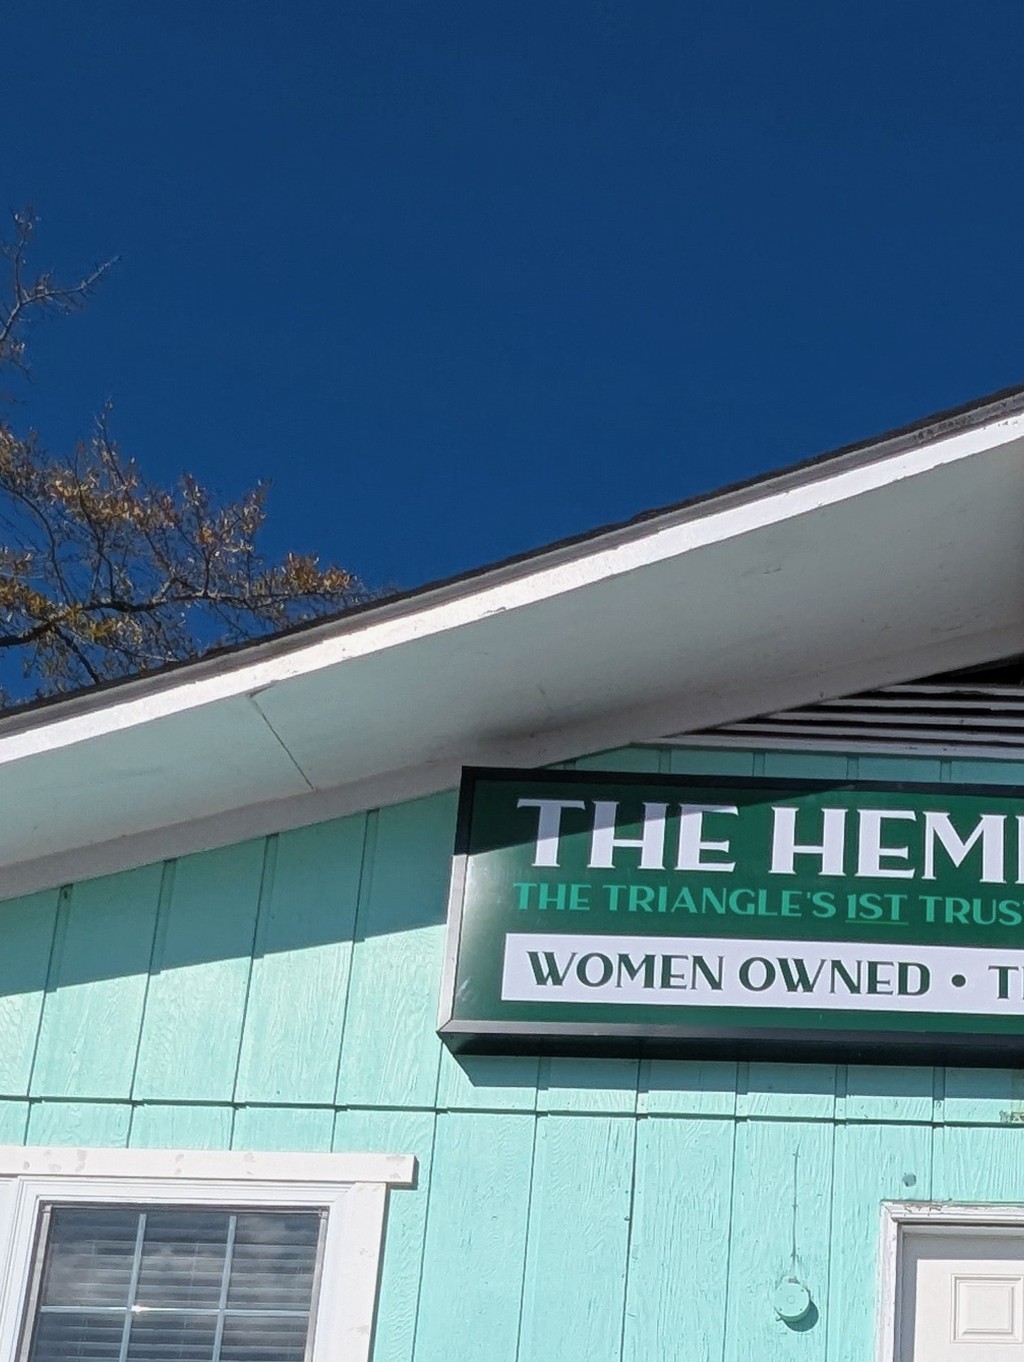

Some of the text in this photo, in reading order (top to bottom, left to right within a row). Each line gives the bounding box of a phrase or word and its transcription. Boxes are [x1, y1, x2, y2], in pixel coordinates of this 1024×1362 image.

[516, 798, 739, 873] THE
[513, 882, 590, 911] THE
[602, 884, 836, 919] TRIANGLE'S
[846, 894, 909, 924] 1ST
[527, 951, 724, 992] WOMEN
[738, 956, 931, 997] OWNED
